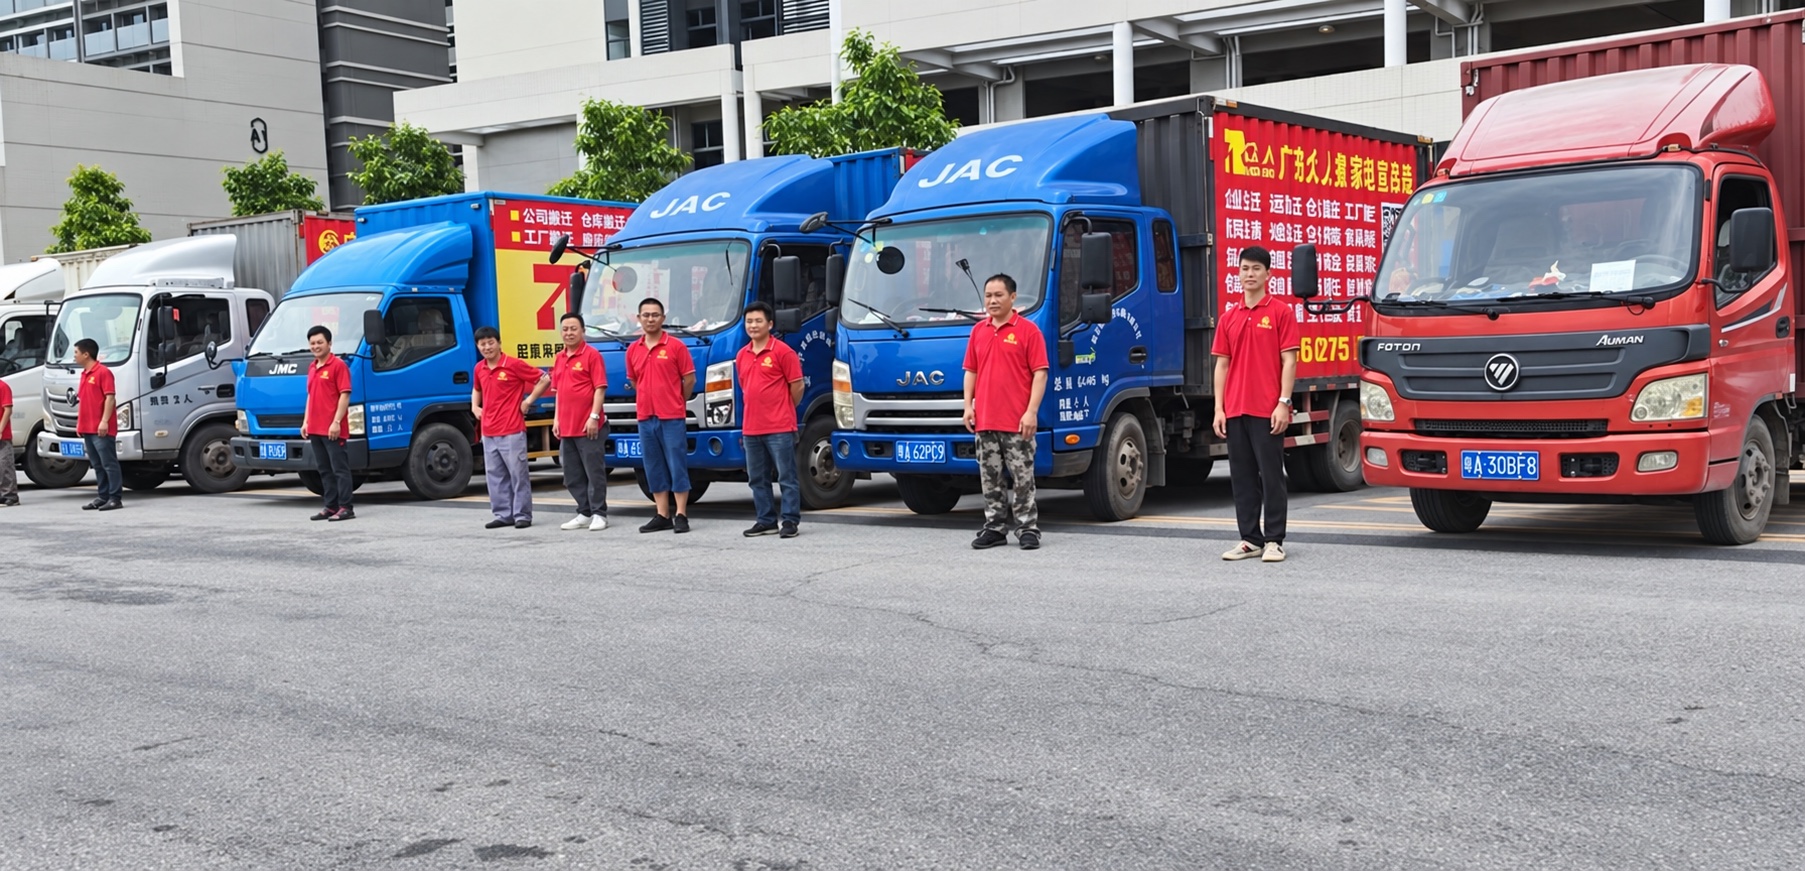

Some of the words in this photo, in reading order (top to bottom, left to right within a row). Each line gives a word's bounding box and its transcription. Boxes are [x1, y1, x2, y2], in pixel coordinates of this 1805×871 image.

[918, 154, 1023, 188] JAC
[650, 191, 731, 219] JAC
[522, 208, 573, 227] 公司搬迁
[1377, 342, 1421, 352] FOTON
[268, 363, 298, 375] JMC
[896, 370, 945, 387] JAC
